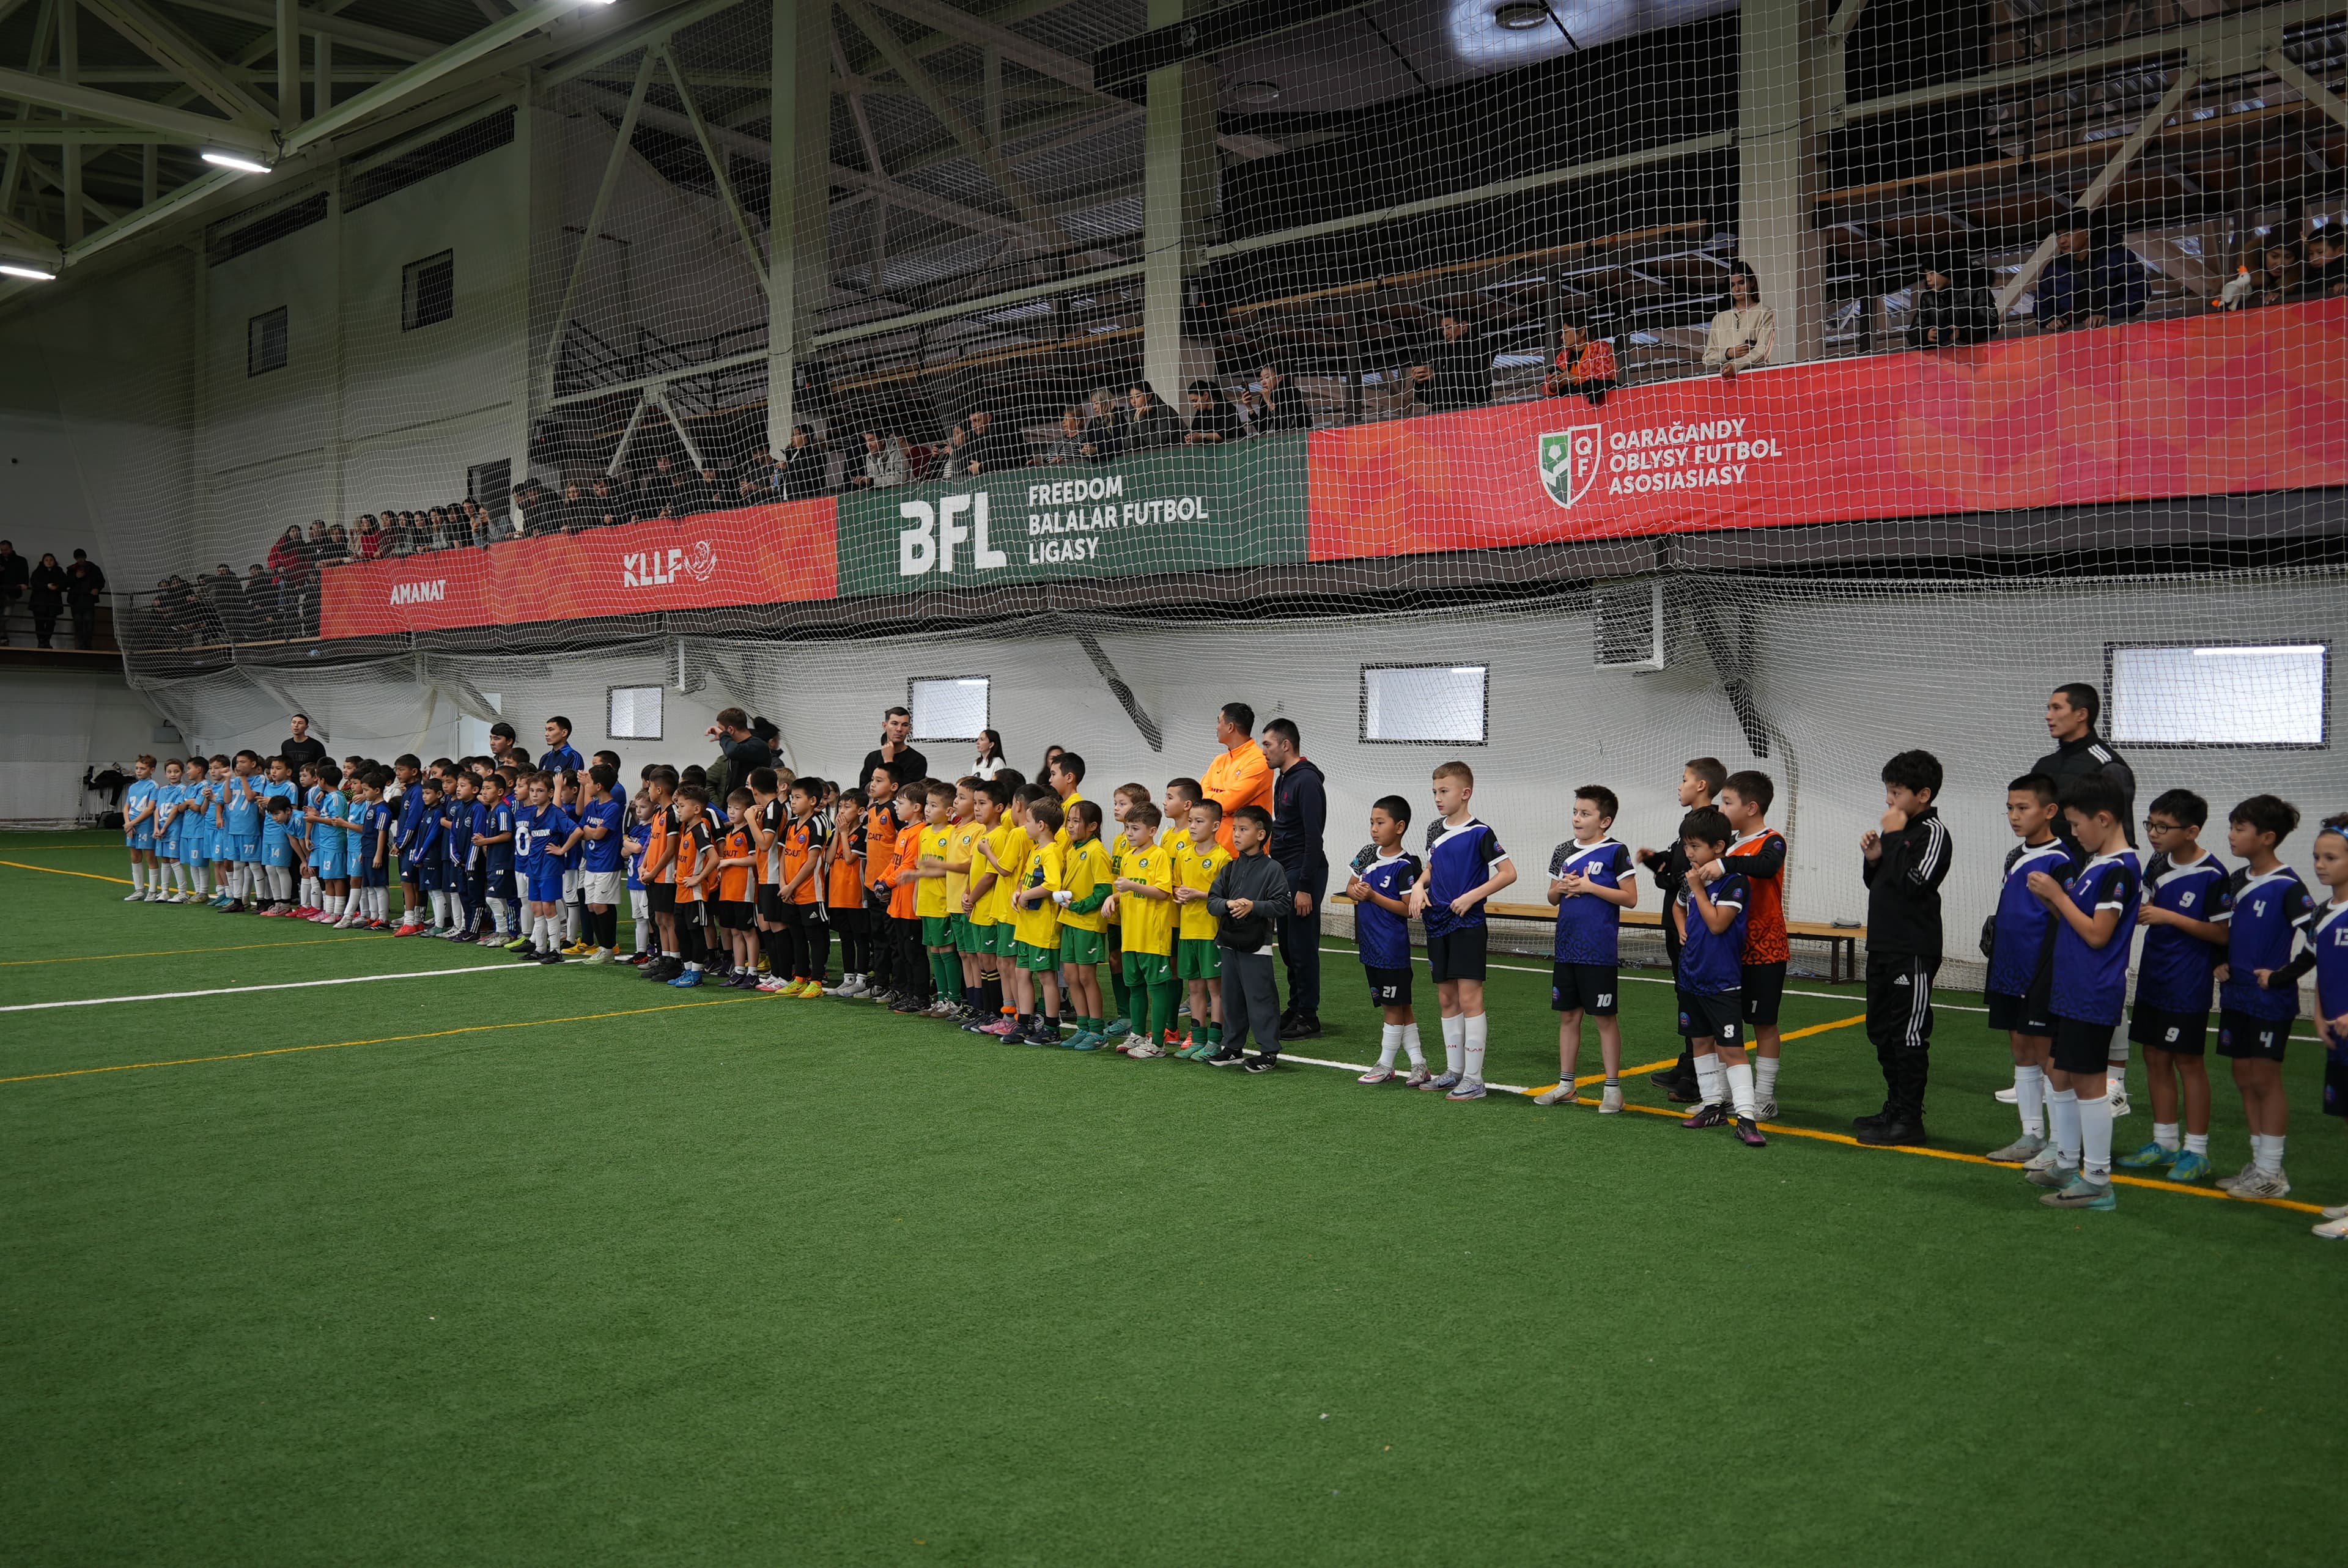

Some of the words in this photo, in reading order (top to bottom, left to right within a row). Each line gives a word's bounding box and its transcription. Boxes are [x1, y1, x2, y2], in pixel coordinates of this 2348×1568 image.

[1610, 418, 1746, 450] QARAĞANDY
[1575, 436, 1592, 455] Q
[1609, 447, 1688, 473] OBLYSY
[1694, 438, 1782, 465] FUTBOL
[1609, 465, 1746, 495] ASOSIASIASY
[1028, 475, 1123, 507] FREEDOM
[1028, 506, 1117, 536] BALALAR
[1123, 496, 1208, 526] FUTBOL
[900, 491, 1007, 576] BFL
[1028, 537, 1099, 564] LIGASY
[624, 549, 682, 587] KLLF
[390, 580, 446, 605] AMANAT
[244, 844, 254, 854] 77
[272, 848, 279, 858] 14
[1588, 861, 1603, 875] 10
[1380, 875, 1391, 888] 3
[2079, 879, 2092, 896] 7
[2179, 891, 2196, 908] 9
[2253, 899, 2266, 917] 4
[1383, 985, 1397, 998] 21
[1597, 993, 1612, 1007] 10
[1751, 1000, 1757, 1013] 1
[1724, 1024, 1735, 1038] 8
[2165, 1027, 2180, 1042] 9
[2259, 1031, 2273, 1047] 4
